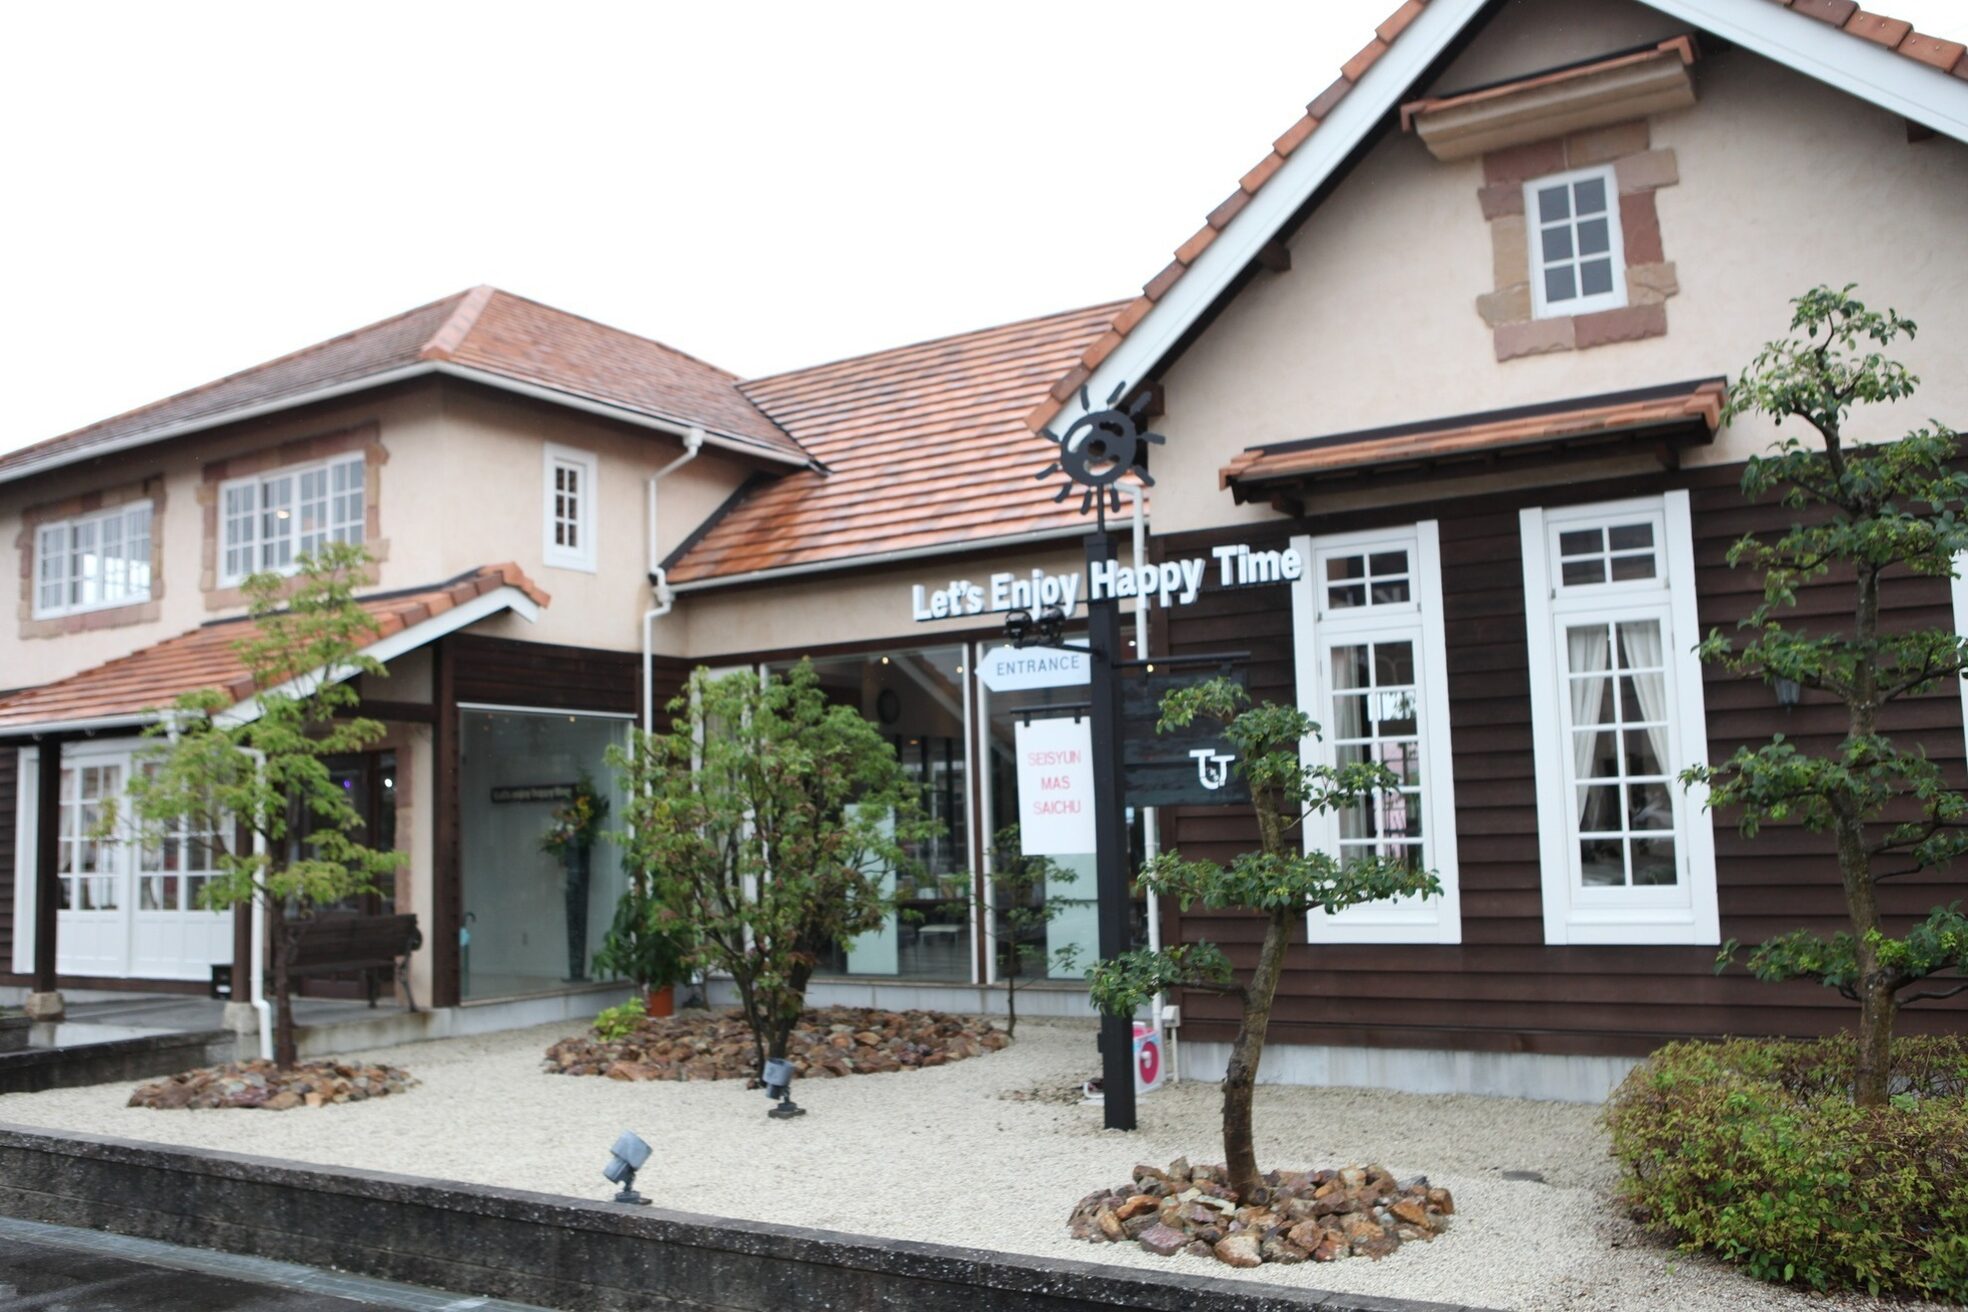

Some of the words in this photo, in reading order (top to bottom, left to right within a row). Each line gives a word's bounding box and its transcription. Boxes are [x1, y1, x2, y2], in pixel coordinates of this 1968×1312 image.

[912, 580, 984, 622] Let's
[990, 568, 1081, 621] Enjoy
[1090, 557, 1205, 610] Happy
[1212, 543, 1303, 587] Time
[996, 655, 1080, 677] ENTRANCE
[1028, 750, 1081, 767] SEISYUN
[1041, 775, 1071, 791] MAS
[1033, 799, 1082, 816] SAICHU
